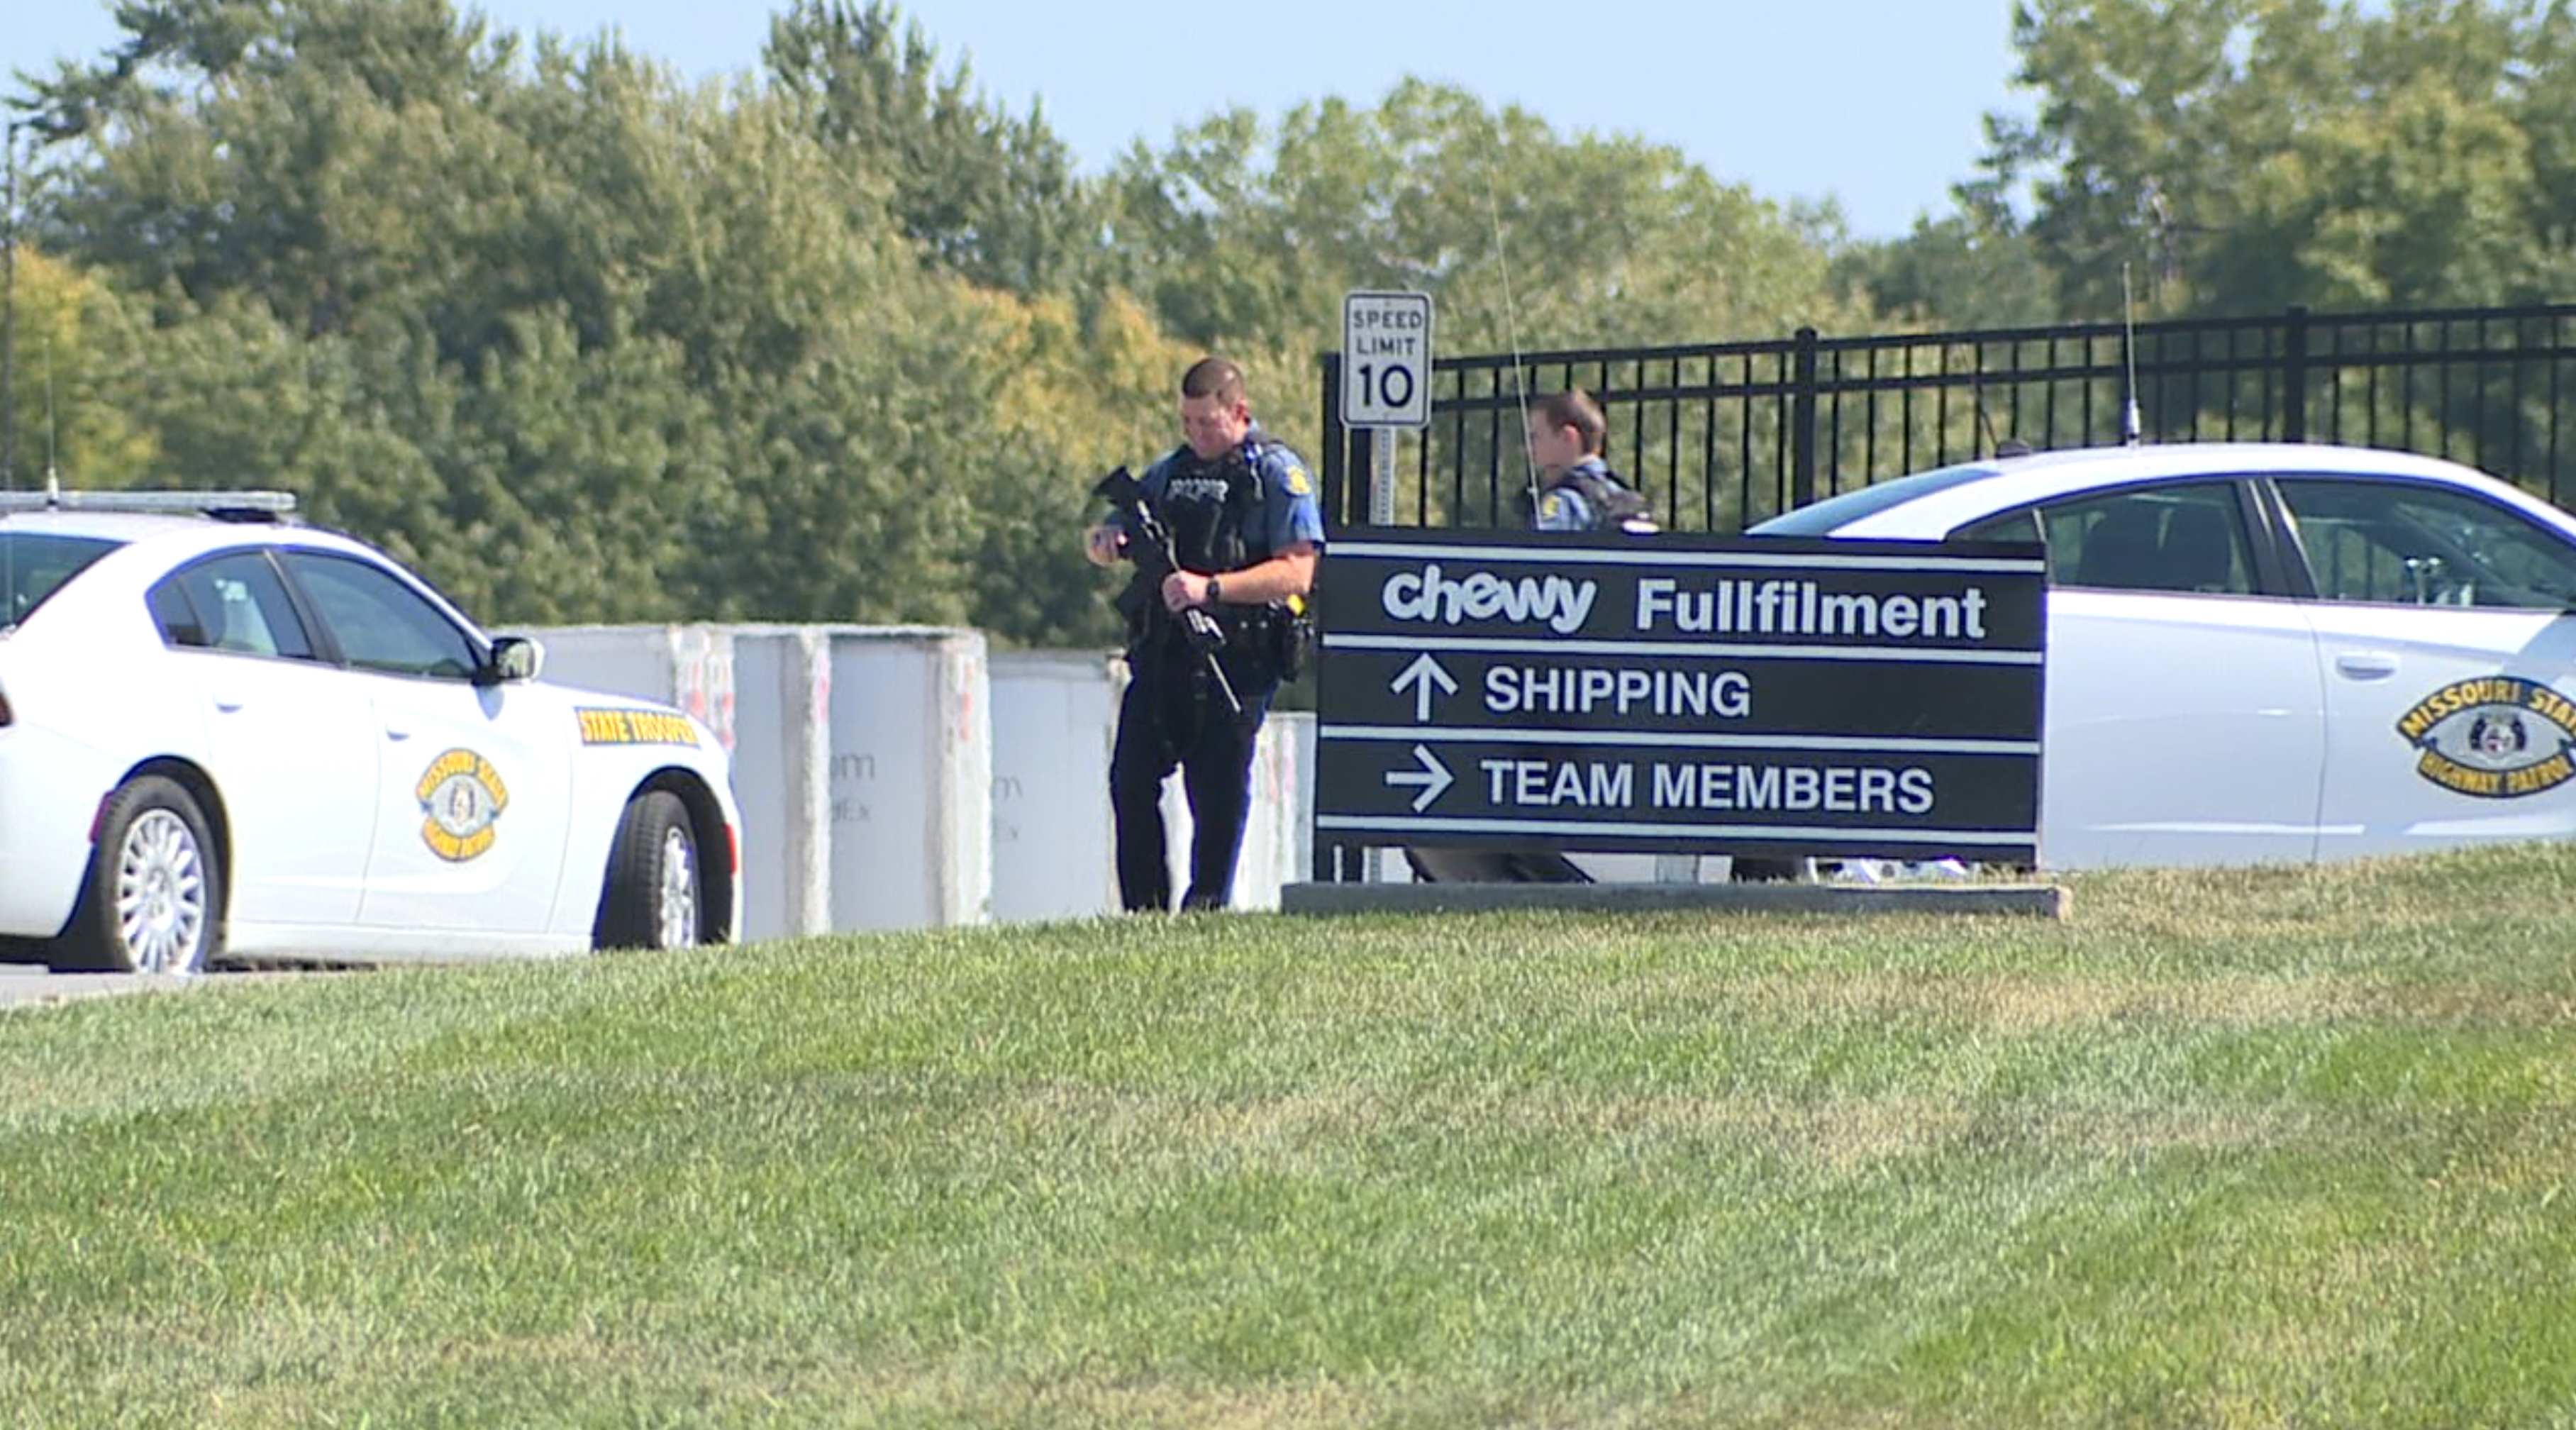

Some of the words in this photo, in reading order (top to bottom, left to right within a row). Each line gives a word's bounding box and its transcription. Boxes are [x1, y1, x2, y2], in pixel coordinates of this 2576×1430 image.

[1353, 310, 1422, 329] SPEED
[1357, 337, 1415, 355] LIMIT
[1358, 364, 1414, 408] 10
[1383, 564, 1596, 633] chewy
[1636, 578, 1986, 638] Fullfilment
[1485, 665, 1750, 716] SHIPPING
[2401, 680, 2521, 737] MISSOURI
[1479, 759, 1633, 807] TEAM
[1653, 763, 1934, 813] MEMBERS
